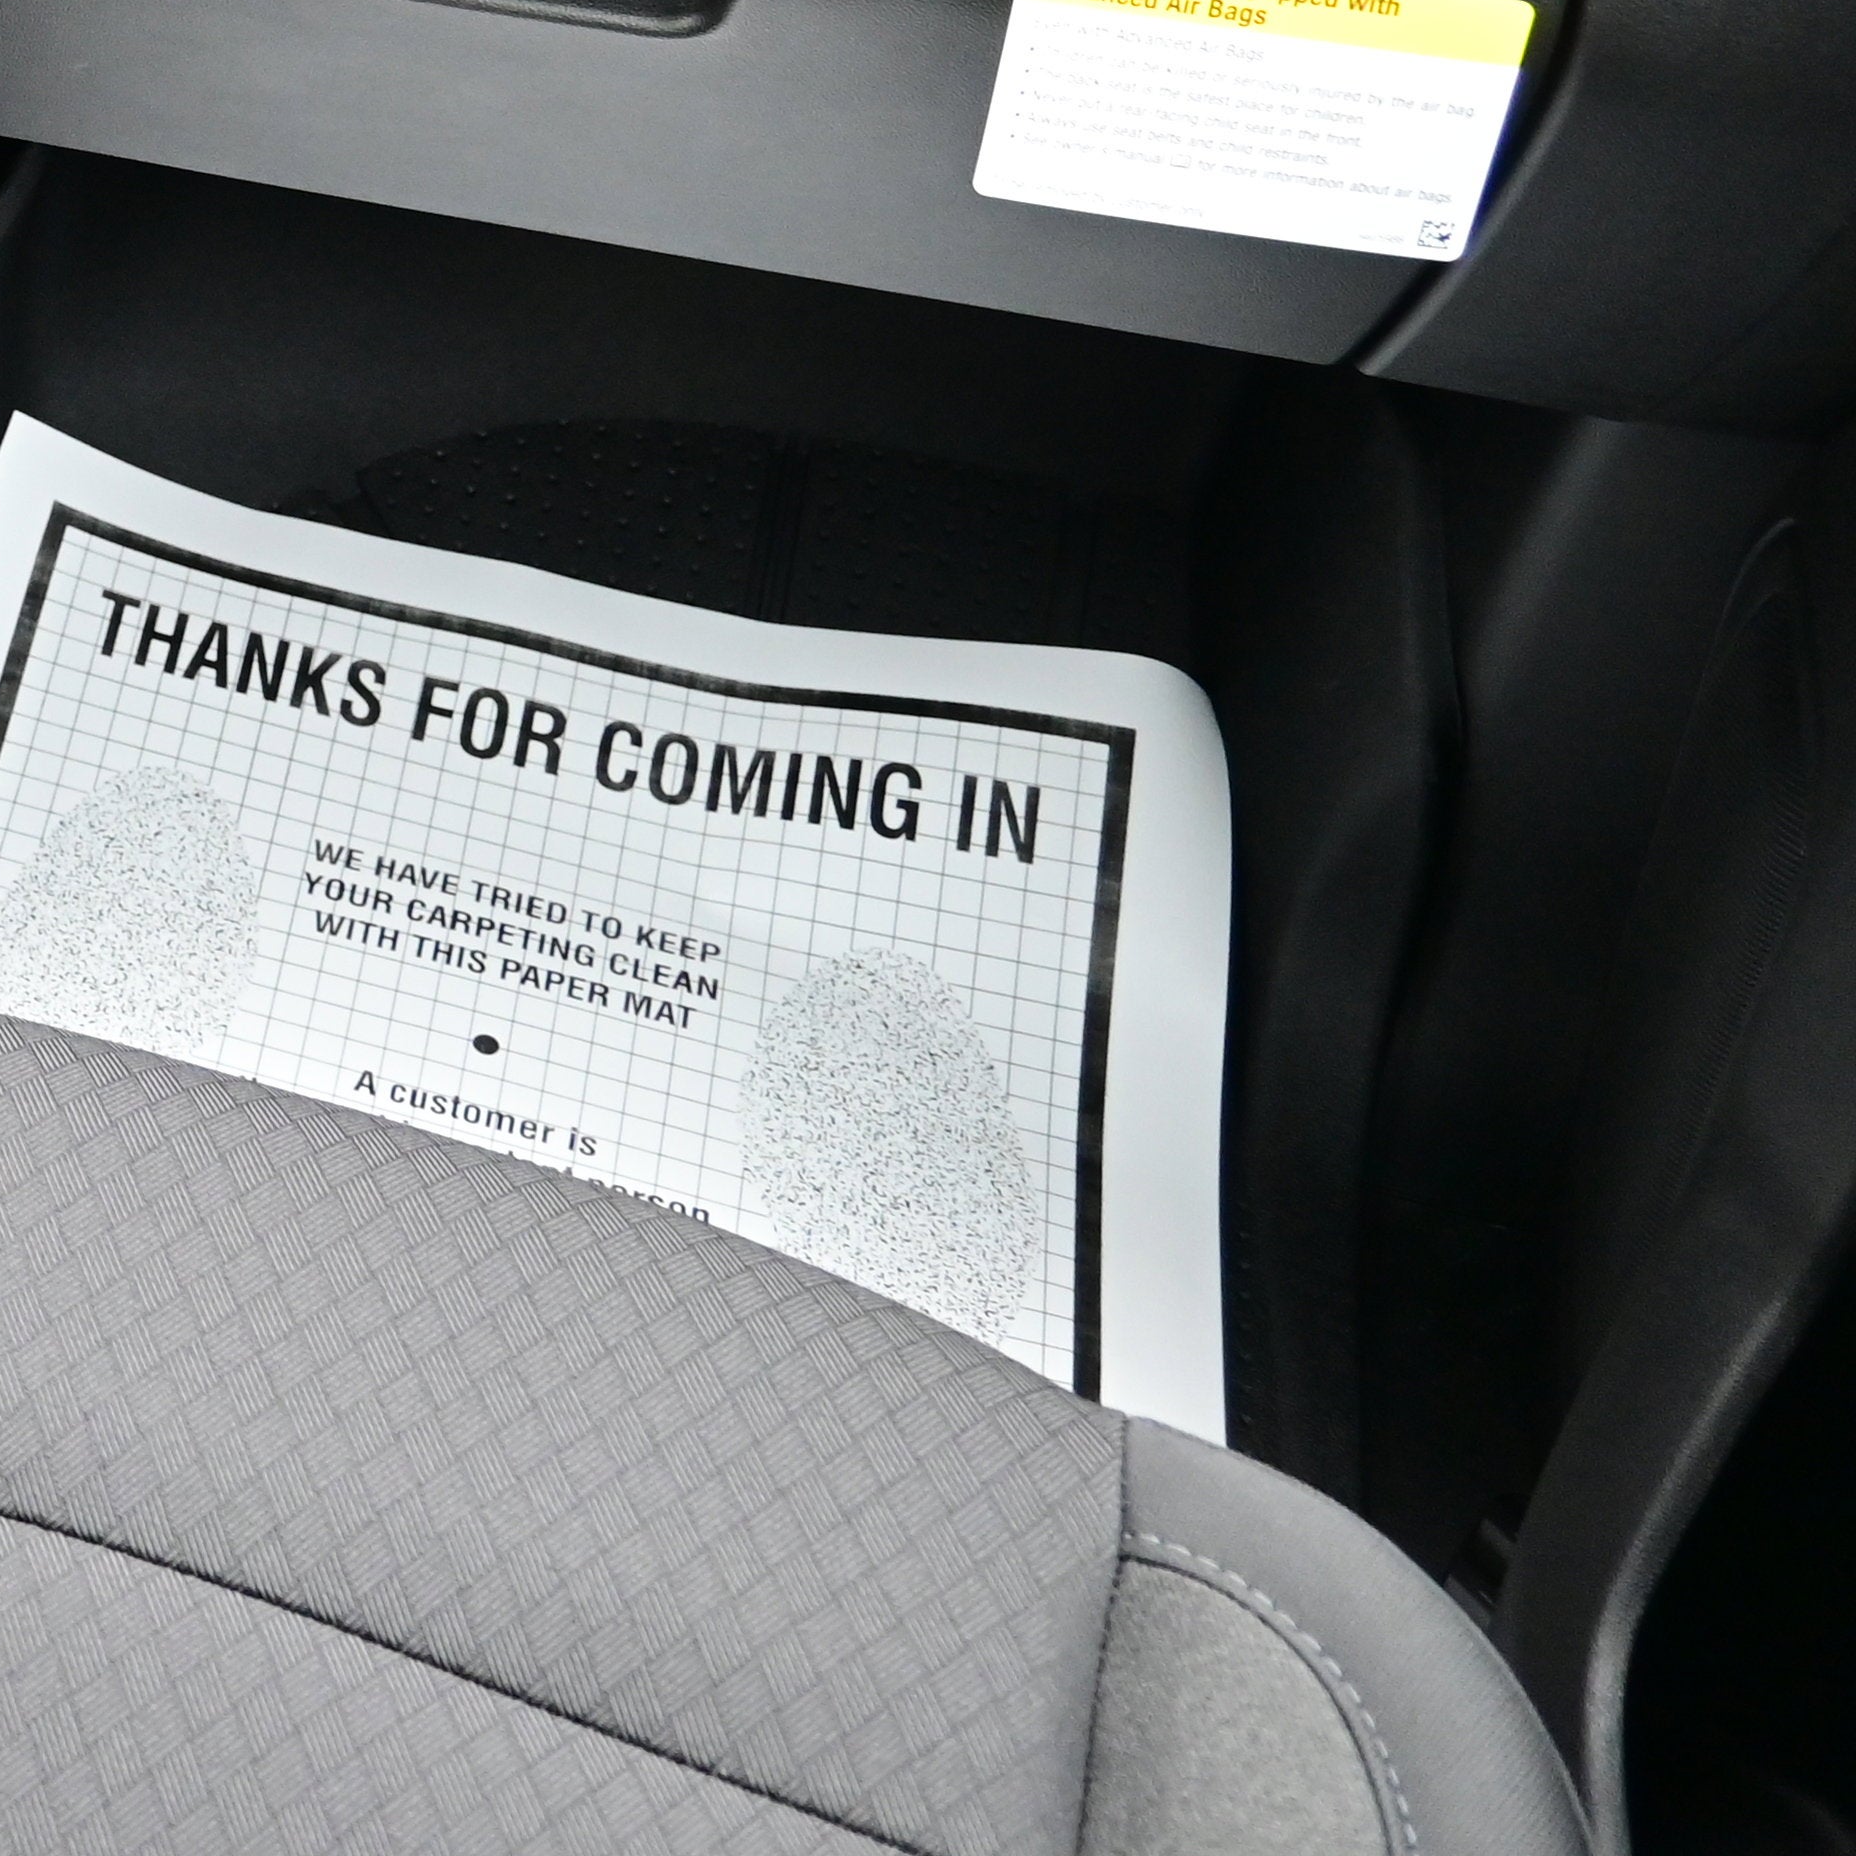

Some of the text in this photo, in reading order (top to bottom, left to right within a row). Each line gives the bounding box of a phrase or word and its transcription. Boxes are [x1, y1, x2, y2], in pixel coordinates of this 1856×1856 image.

[101, 588, 1041, 864] THANKS FOR COMING IN
[304, 871, 719, 1001] YOUR CARPETING CLEAN
[315, 839, 722, 964] WE HAVE TRIED TO KEEP
[315, 910, 698, 1029] WITH THIS PAPER MAT
[353, 1070, 598, 1157] A customer is
